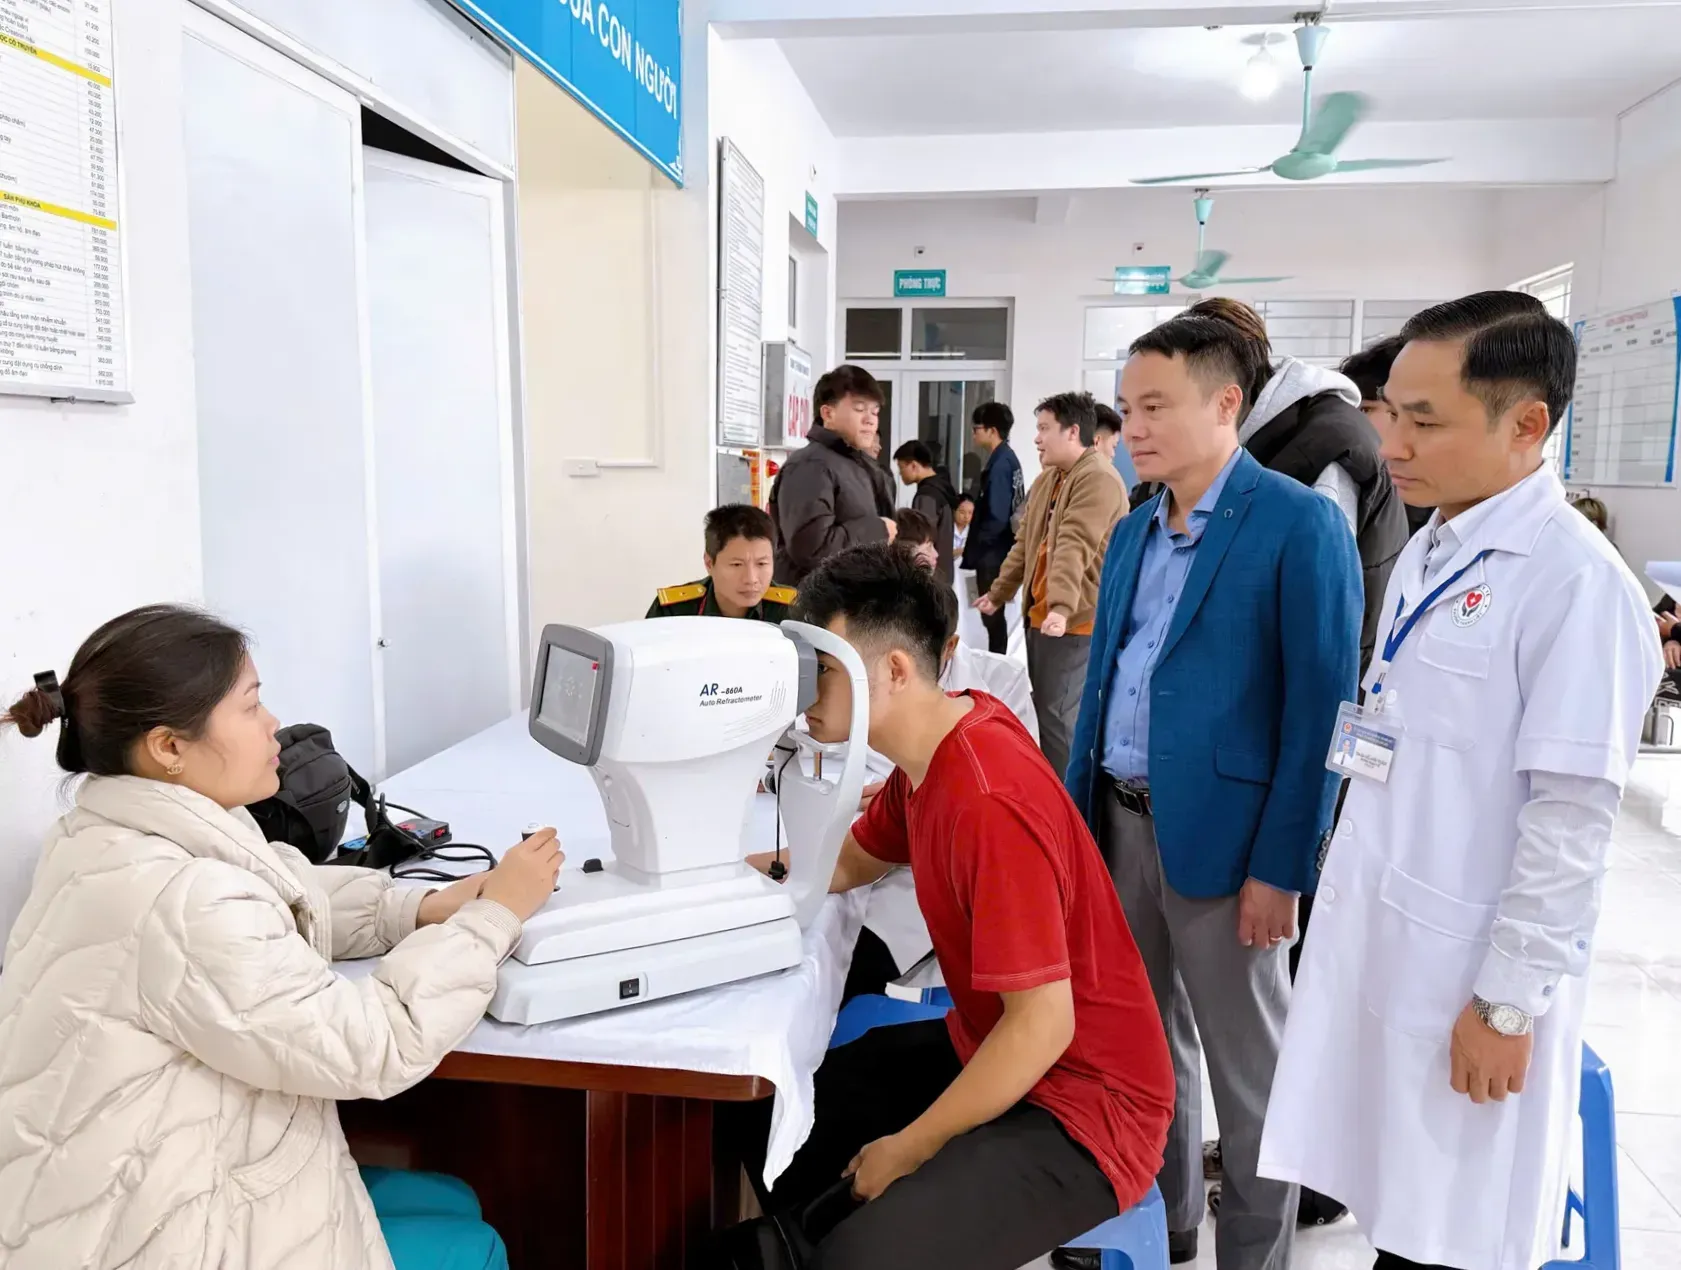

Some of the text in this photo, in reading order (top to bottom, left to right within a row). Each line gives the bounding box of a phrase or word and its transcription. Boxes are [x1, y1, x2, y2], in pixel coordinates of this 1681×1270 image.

[598, 3, 631, 73] CON
[636, 40, 677, 120] NGƯỜI
[899, 275, 922, 289] PHÒNG
[699, 683, 719, 697] AR
[699, 695, 762, 707] Auto Refractometer
